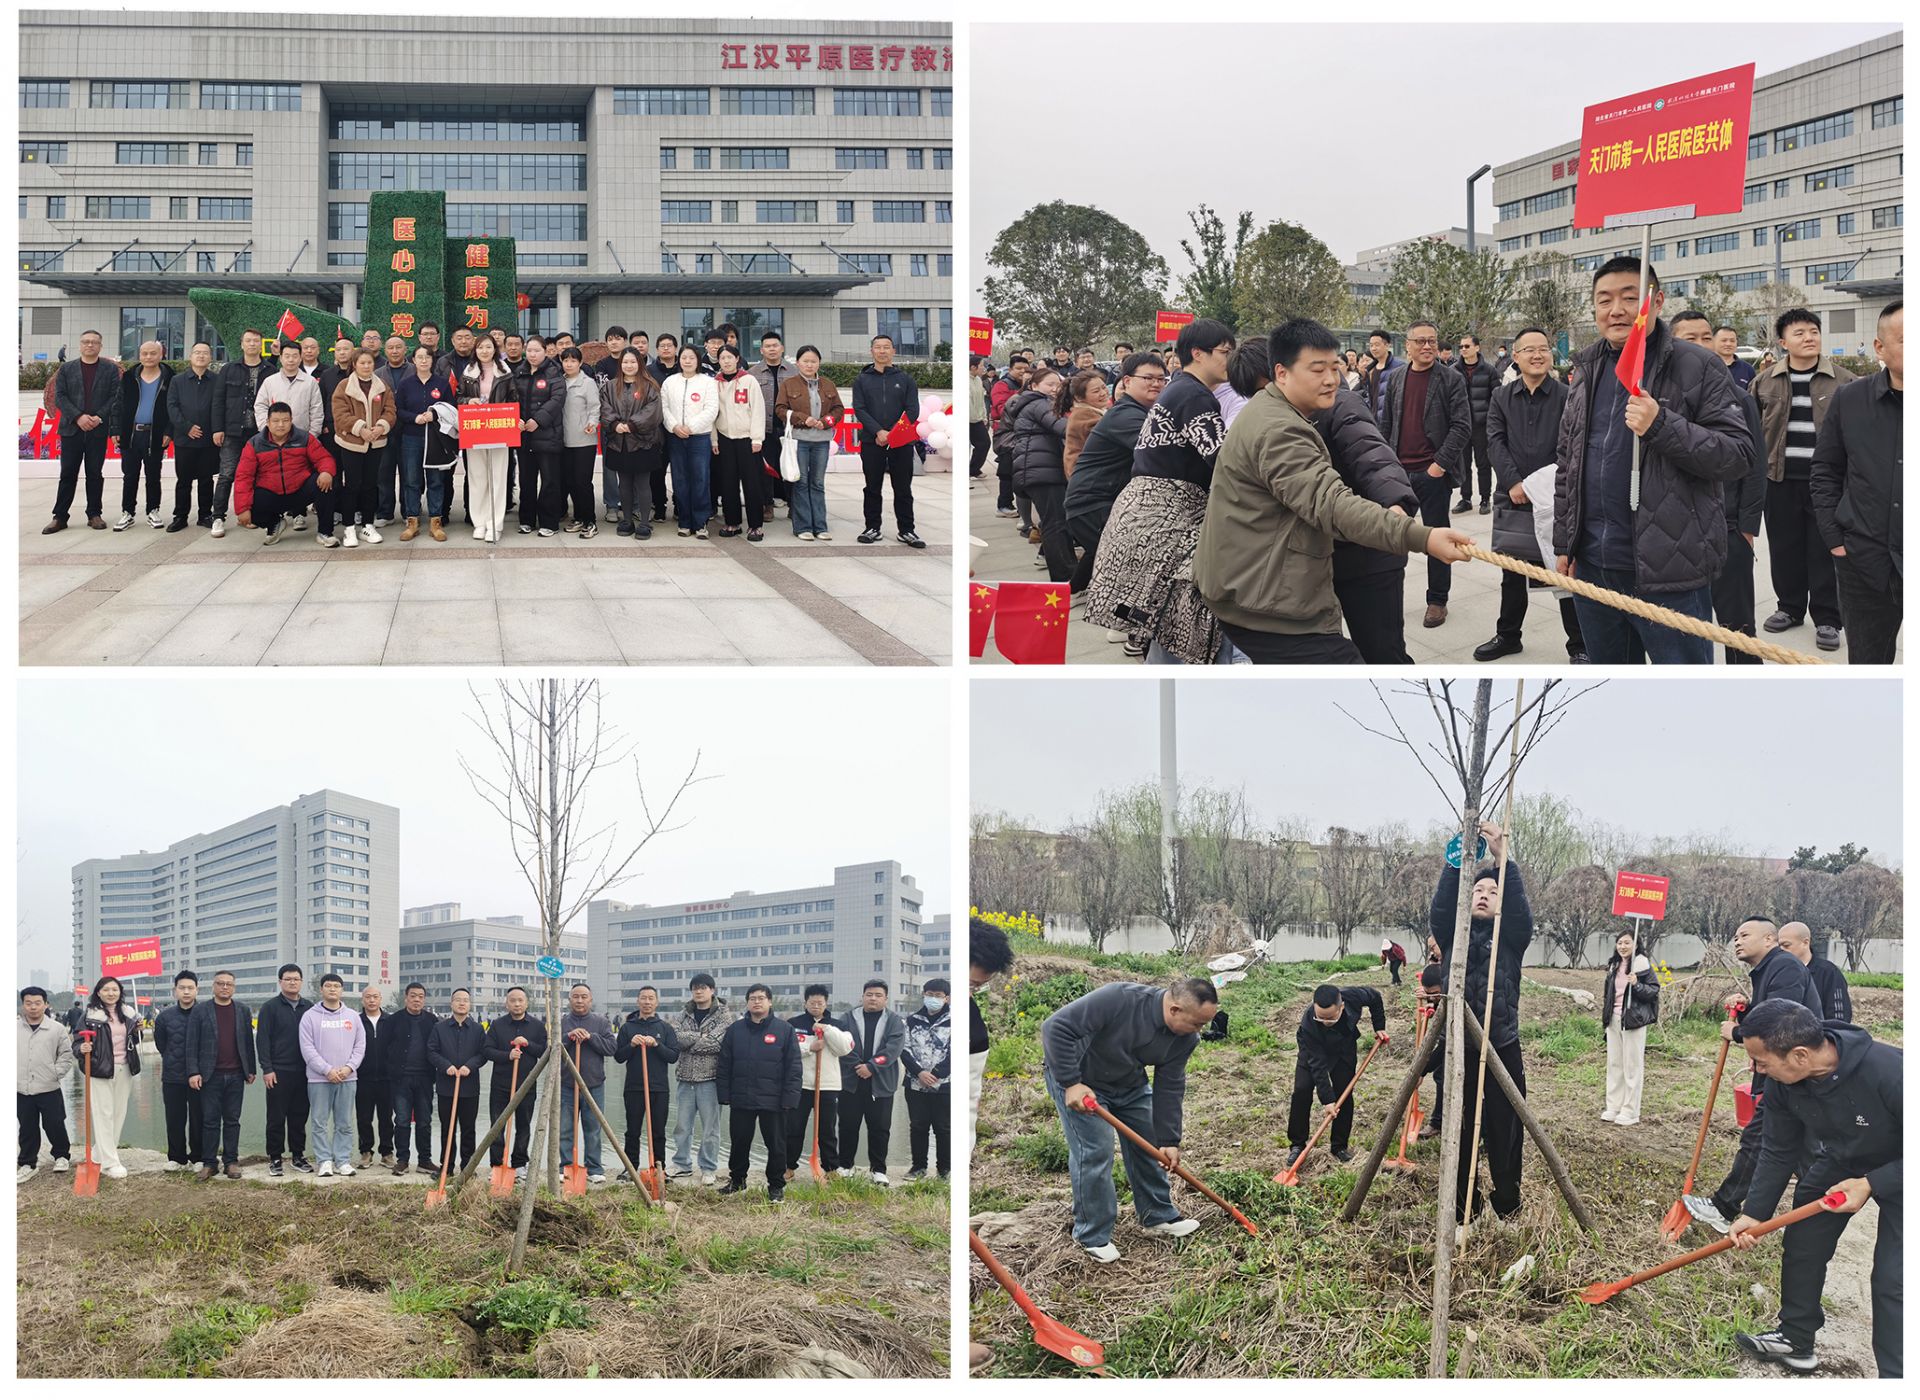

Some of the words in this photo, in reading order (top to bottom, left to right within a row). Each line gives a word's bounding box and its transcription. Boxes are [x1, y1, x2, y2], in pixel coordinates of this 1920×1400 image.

[1588, 118, 1734, 175] 天门市第一人民医院医共体
[390, 217, 416, 337] 医心向党
